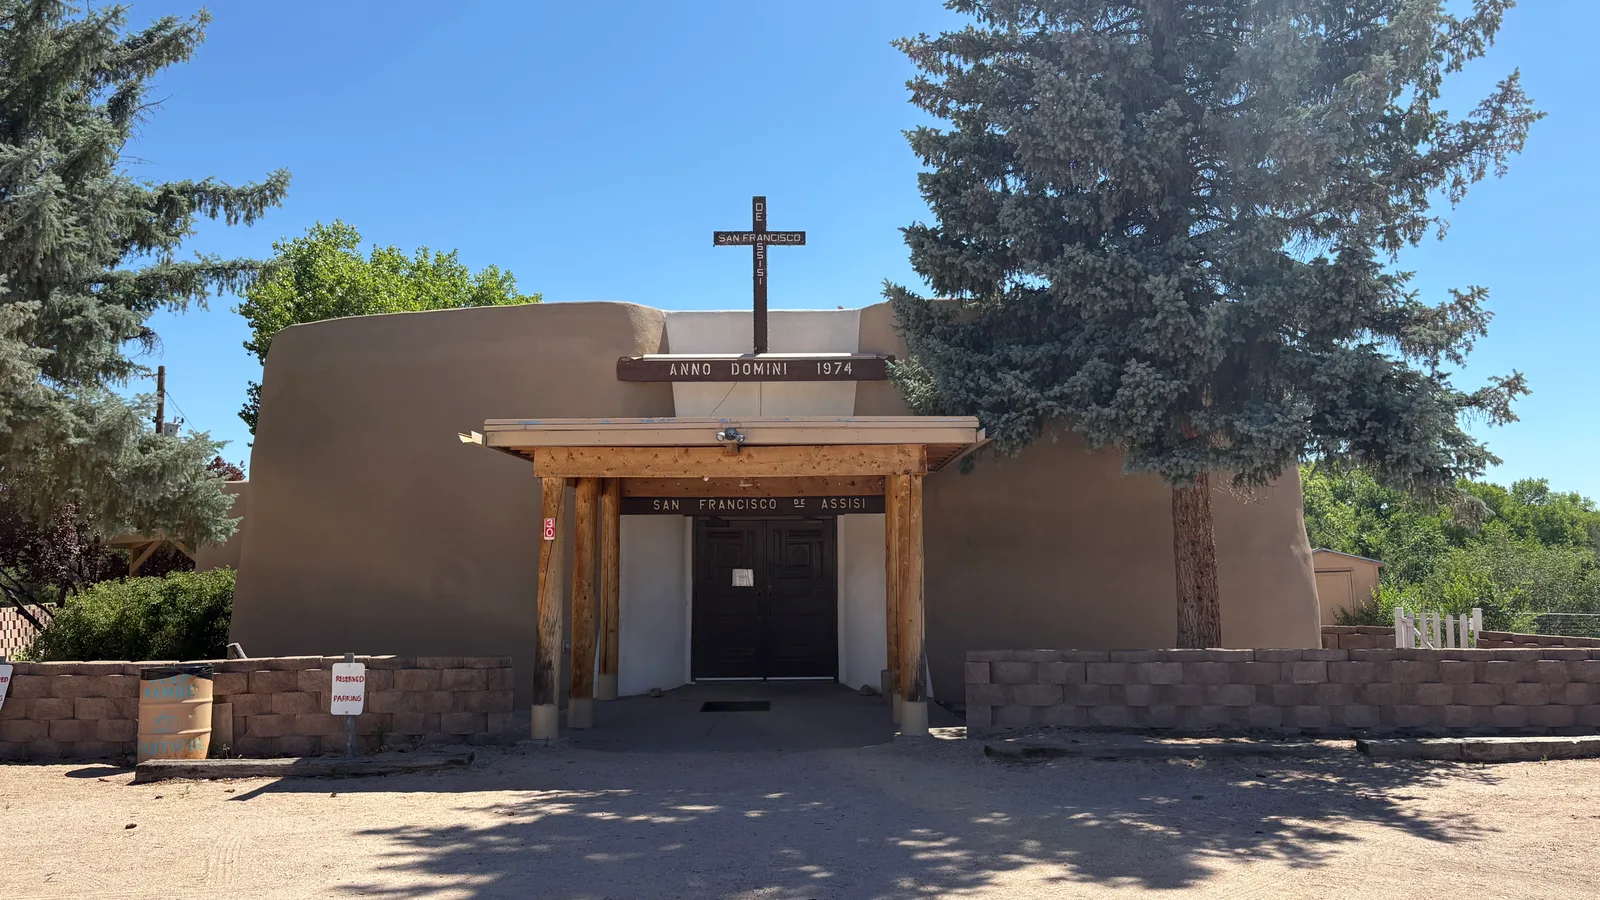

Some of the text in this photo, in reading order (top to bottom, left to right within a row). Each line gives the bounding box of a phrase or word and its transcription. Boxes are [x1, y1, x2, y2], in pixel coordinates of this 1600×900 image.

[755, 202, 763, 221] DE
[718, 233, 801, 242] SAN FRANCISCO
[669, 361, 852, 376] ANNO DOMINI 1974
[653, 498, 866, 510] SAN FRANCISCO DE ASSISI
[546, 519, 554, 537] 30
[335, 675, 365, 683] RESERVED
[333, 694, 362, 702] PARKING
